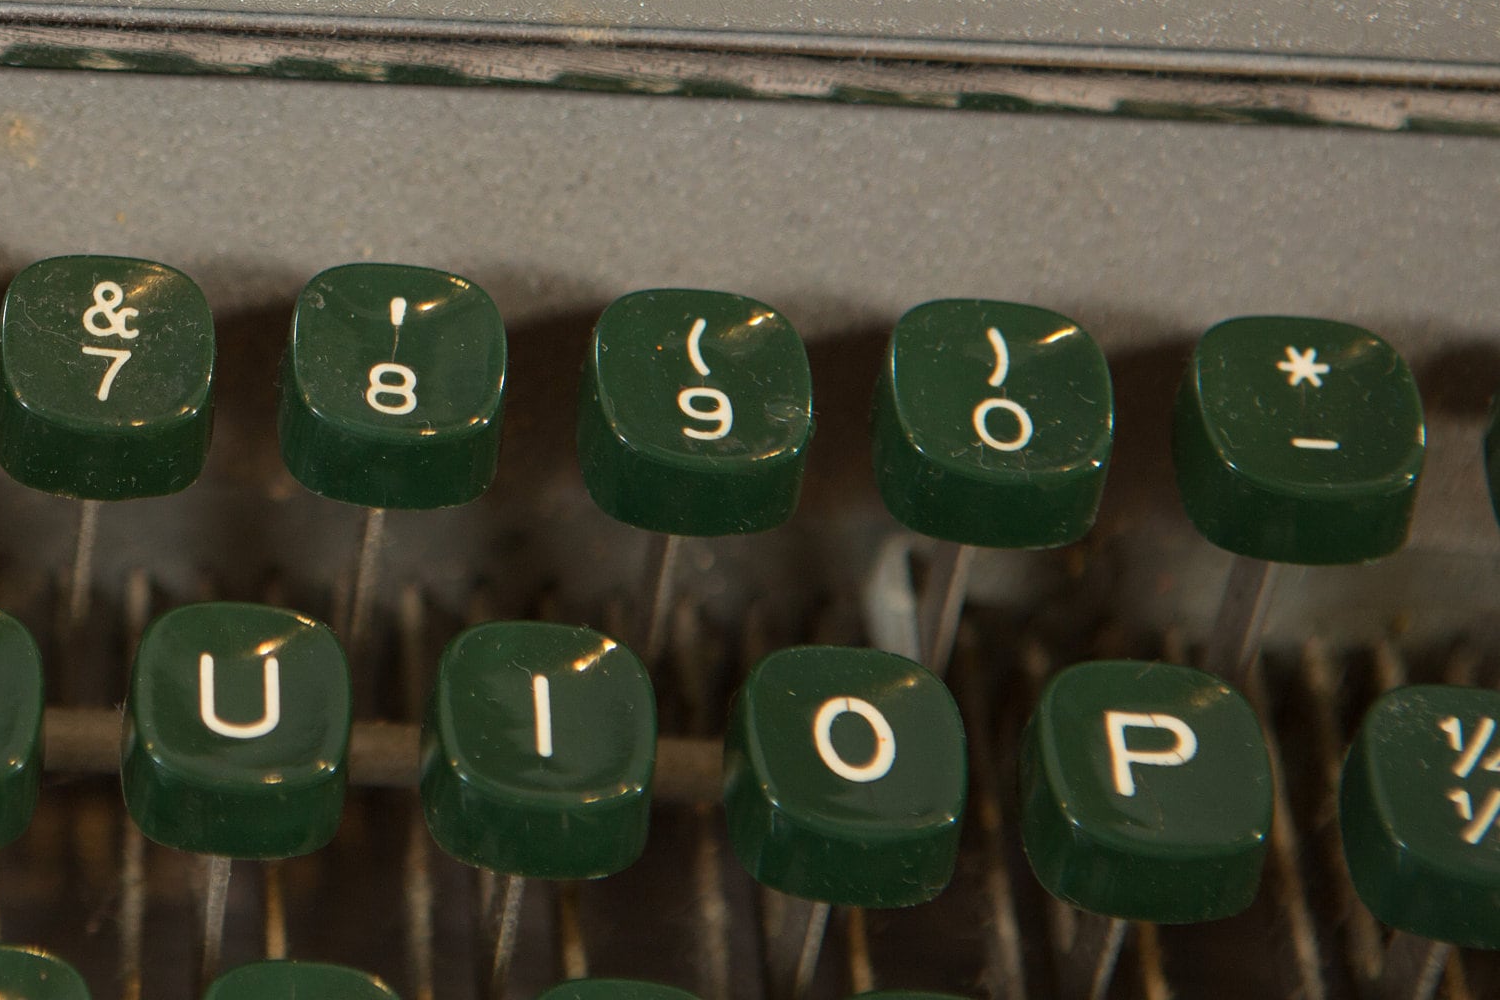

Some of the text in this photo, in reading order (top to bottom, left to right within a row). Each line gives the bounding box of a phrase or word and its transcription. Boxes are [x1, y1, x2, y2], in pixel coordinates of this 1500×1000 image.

[81, 280, 141, 341] &
[80, 344, 133, 403] 7
[364, 362, 419, 416] 8
[676, 386, 735, 441] 9
[199, 652, 281, 740] U
[532, 673, 554, 759] I
[812, 696, 897, 783] O
[1103, 709, 1199, 798] P
